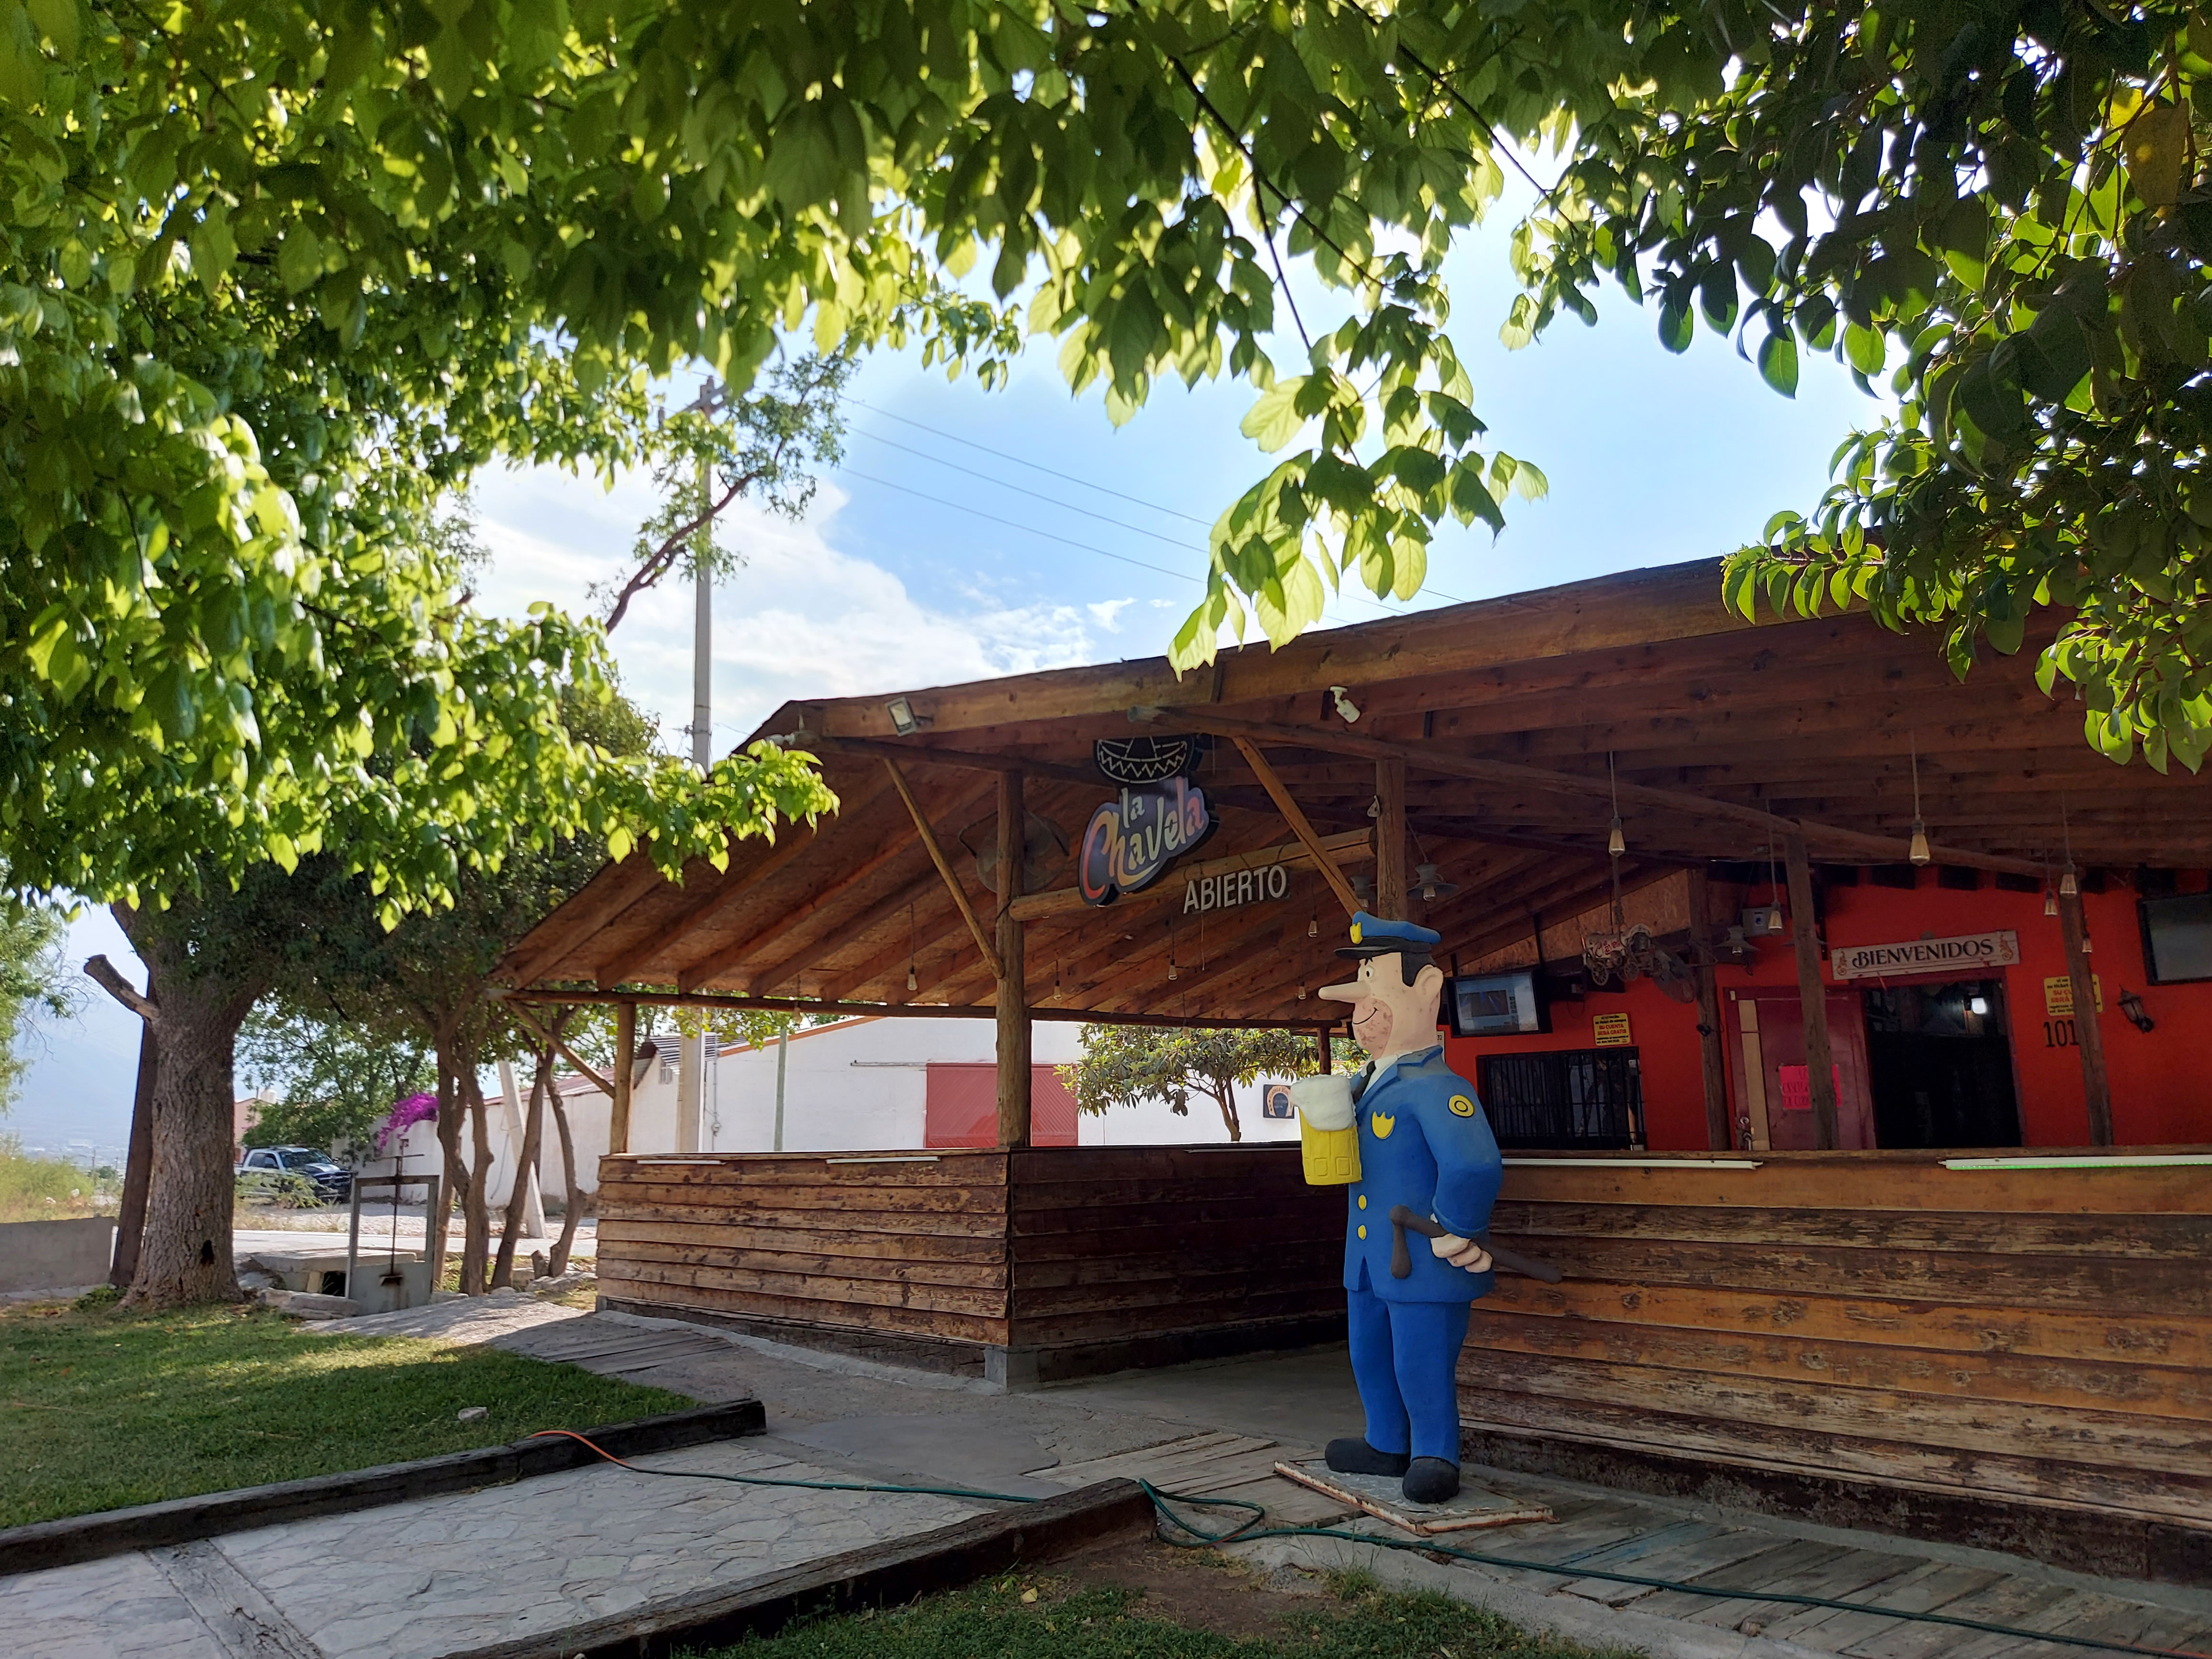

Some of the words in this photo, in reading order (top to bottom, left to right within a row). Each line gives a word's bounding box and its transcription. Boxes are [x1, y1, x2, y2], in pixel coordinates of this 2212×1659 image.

[1121, 787, 1145, 829] la
[1183, 865, 1287, 914] ABIERTO
[1852, 939, 1994, 969] BIENVENIDOS
[2043, 1019, 2079, 1047] 101
